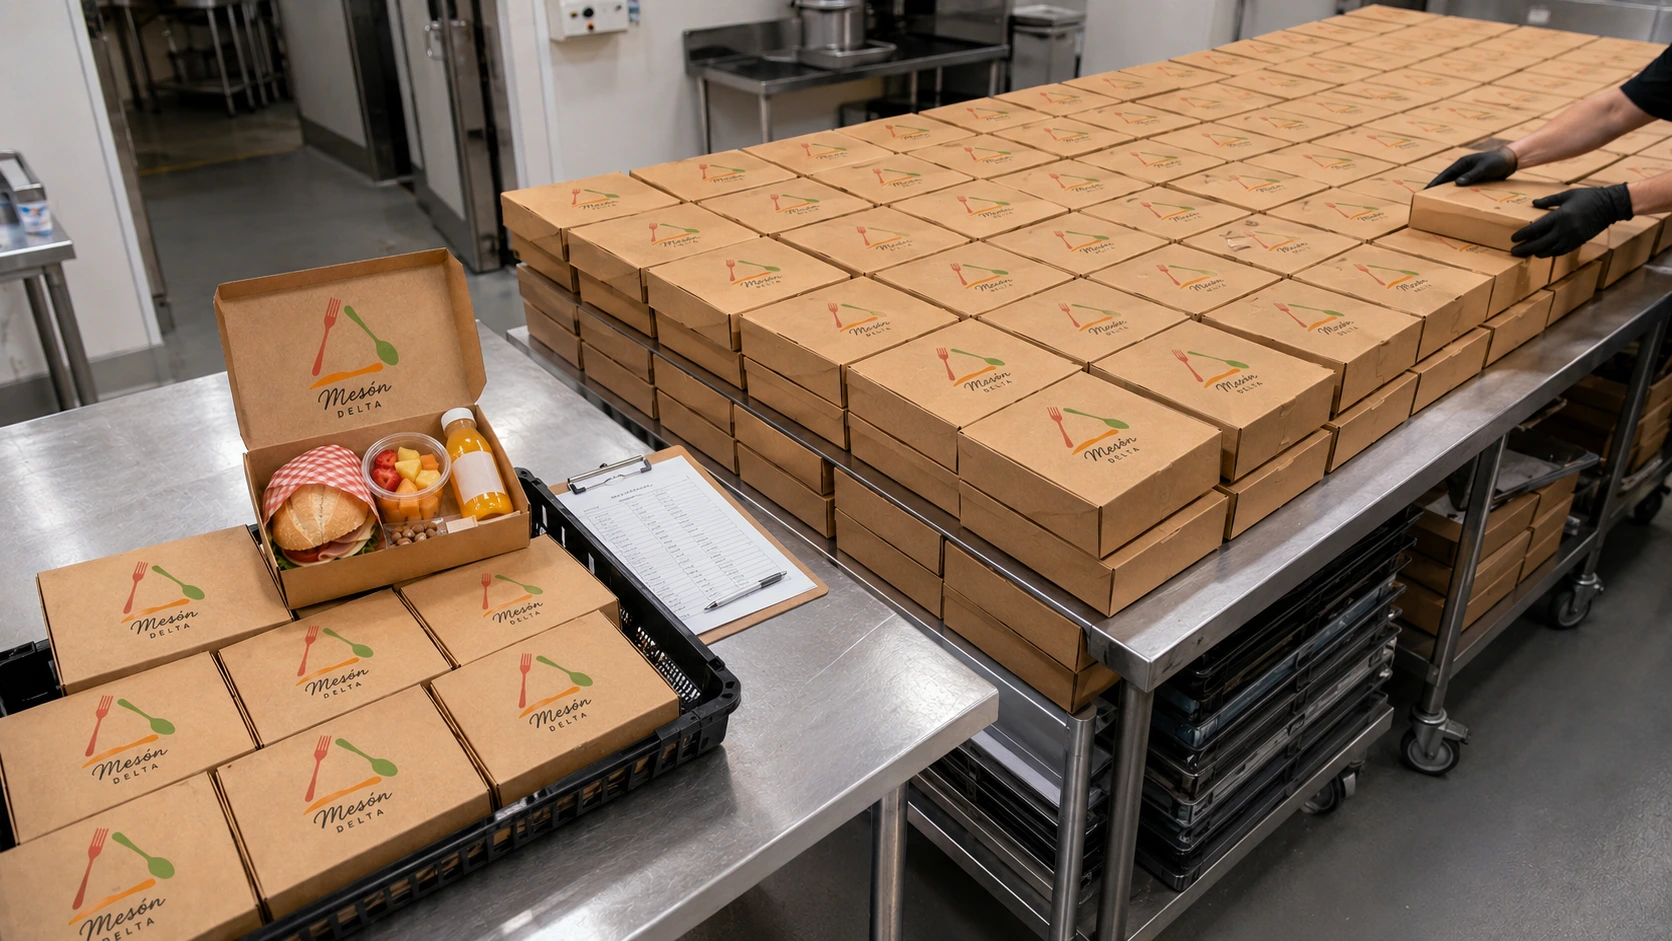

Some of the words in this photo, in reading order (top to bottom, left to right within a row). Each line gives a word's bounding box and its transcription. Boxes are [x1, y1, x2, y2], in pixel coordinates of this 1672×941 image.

[318, 381, 392, 411] Mesón
[337, 400, 382, 419] DELTA
[130, 608, 199, 636] Mesón
[492, 602, 543, 624] Mesón
[510, 611, 540, 625] DELTA
[149, 622, 191, 640] DELTA
[304, 667, 369, 697] Mesón
[323, 681, 362, 699] DELTA
[529, 697, 592, 730] Mesón
[549, 712, 587, 732] DELTA
[92, 747, 169, 781] Mesón
[113, 763, 159, 785] DELTA
[313, 791, 393, 830] Mesón
[336, 808, 385, 834] DELTA
[79, 897, 166, 941] Mesón
